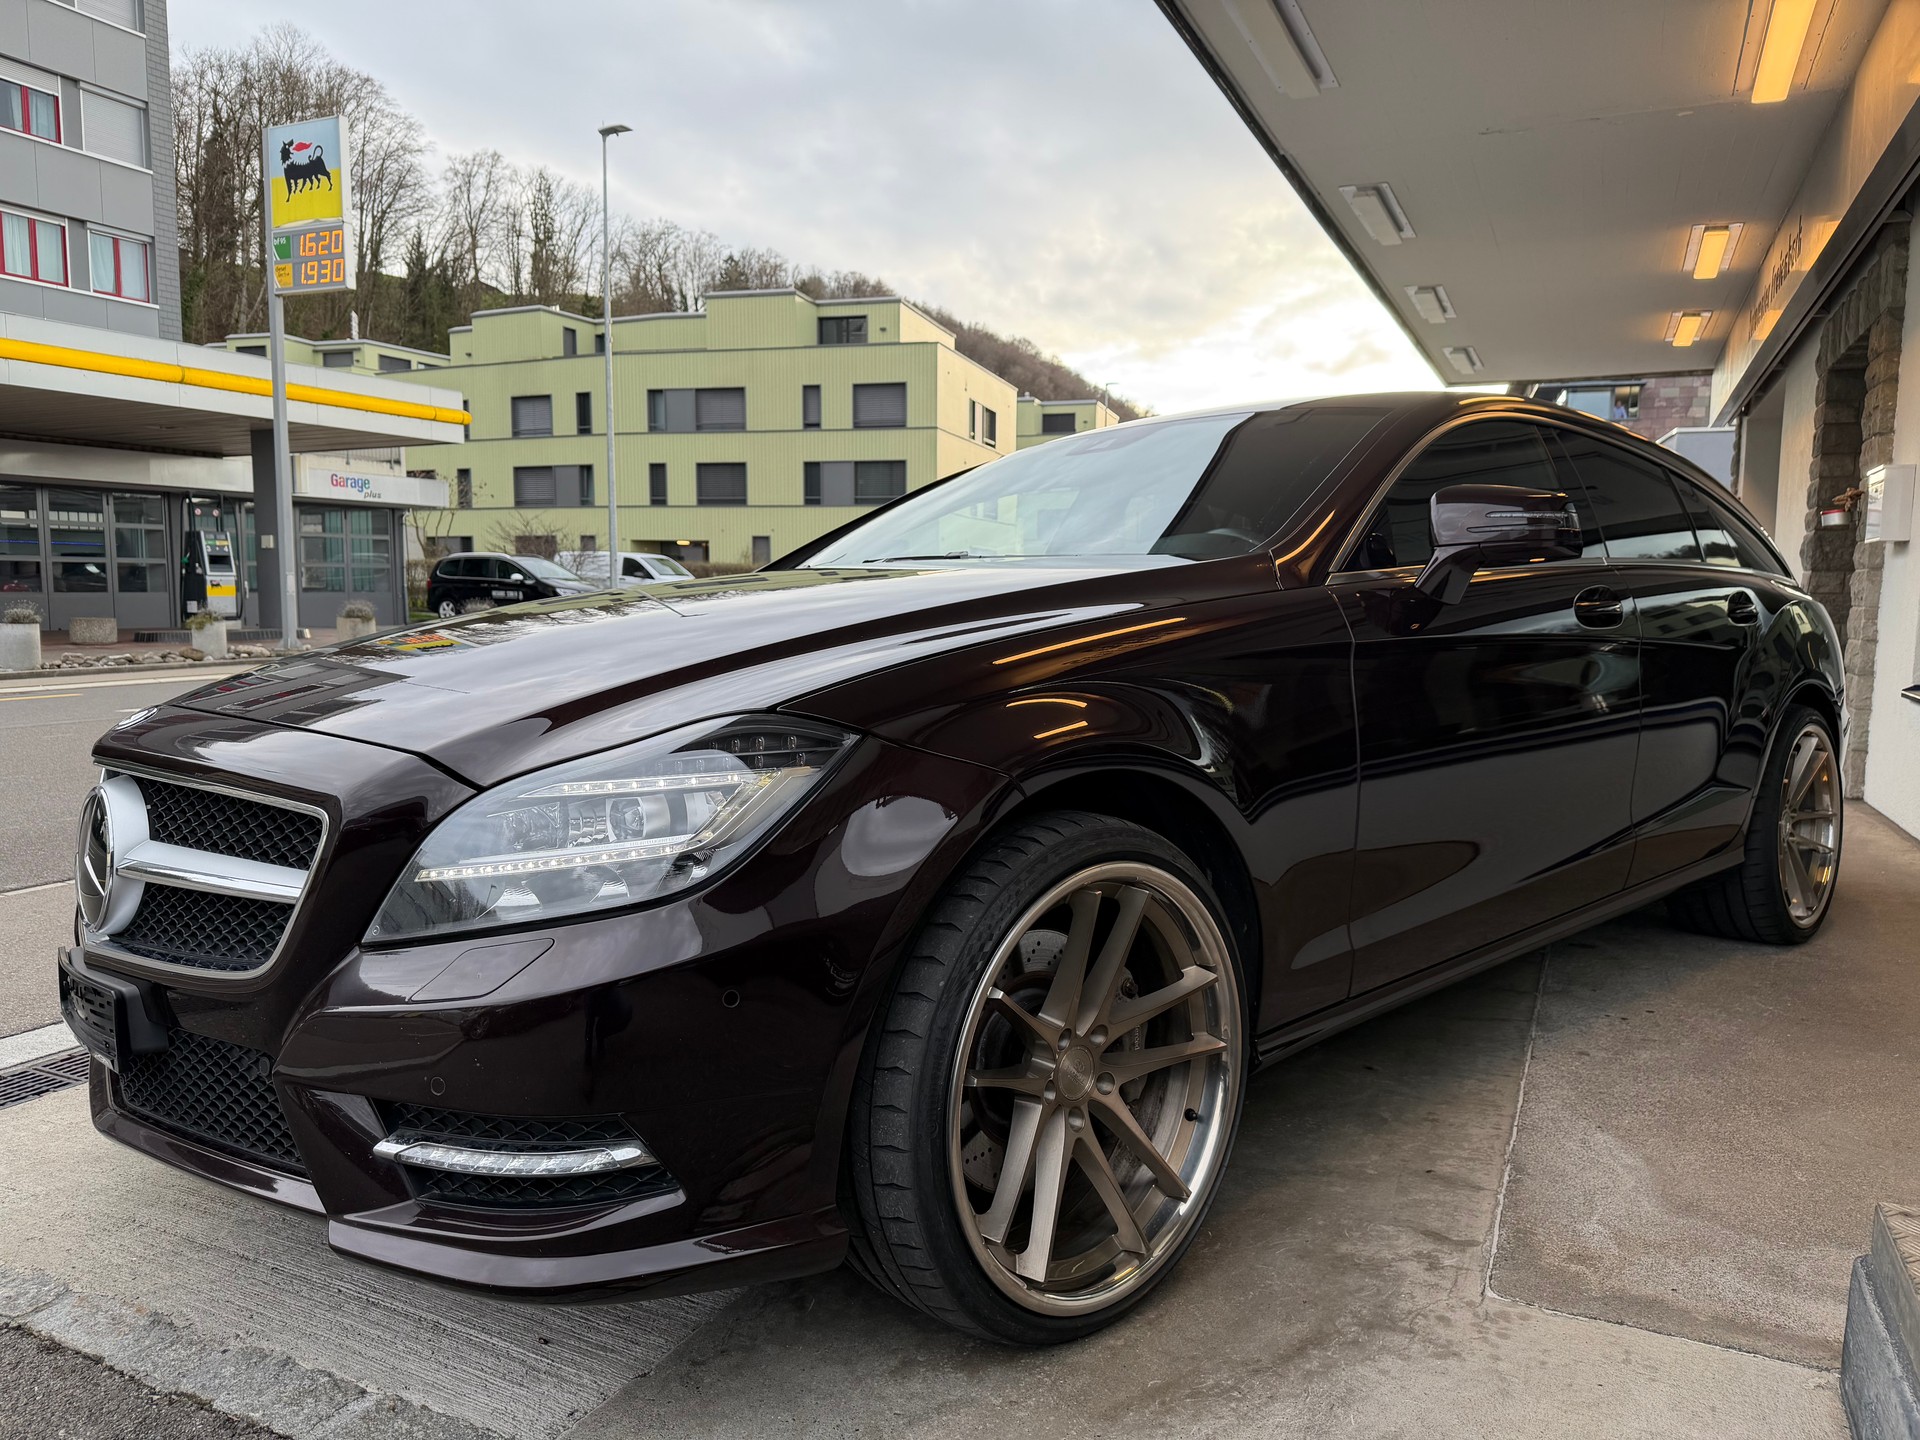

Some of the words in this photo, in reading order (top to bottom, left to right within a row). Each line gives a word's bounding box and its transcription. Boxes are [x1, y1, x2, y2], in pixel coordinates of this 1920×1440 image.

[300, 230, 343, 256] 1.620
[301, 258, 344, 284] 1.930
[331, 473, 370, 493] Garage
[364, 490, 382, 499] plus
